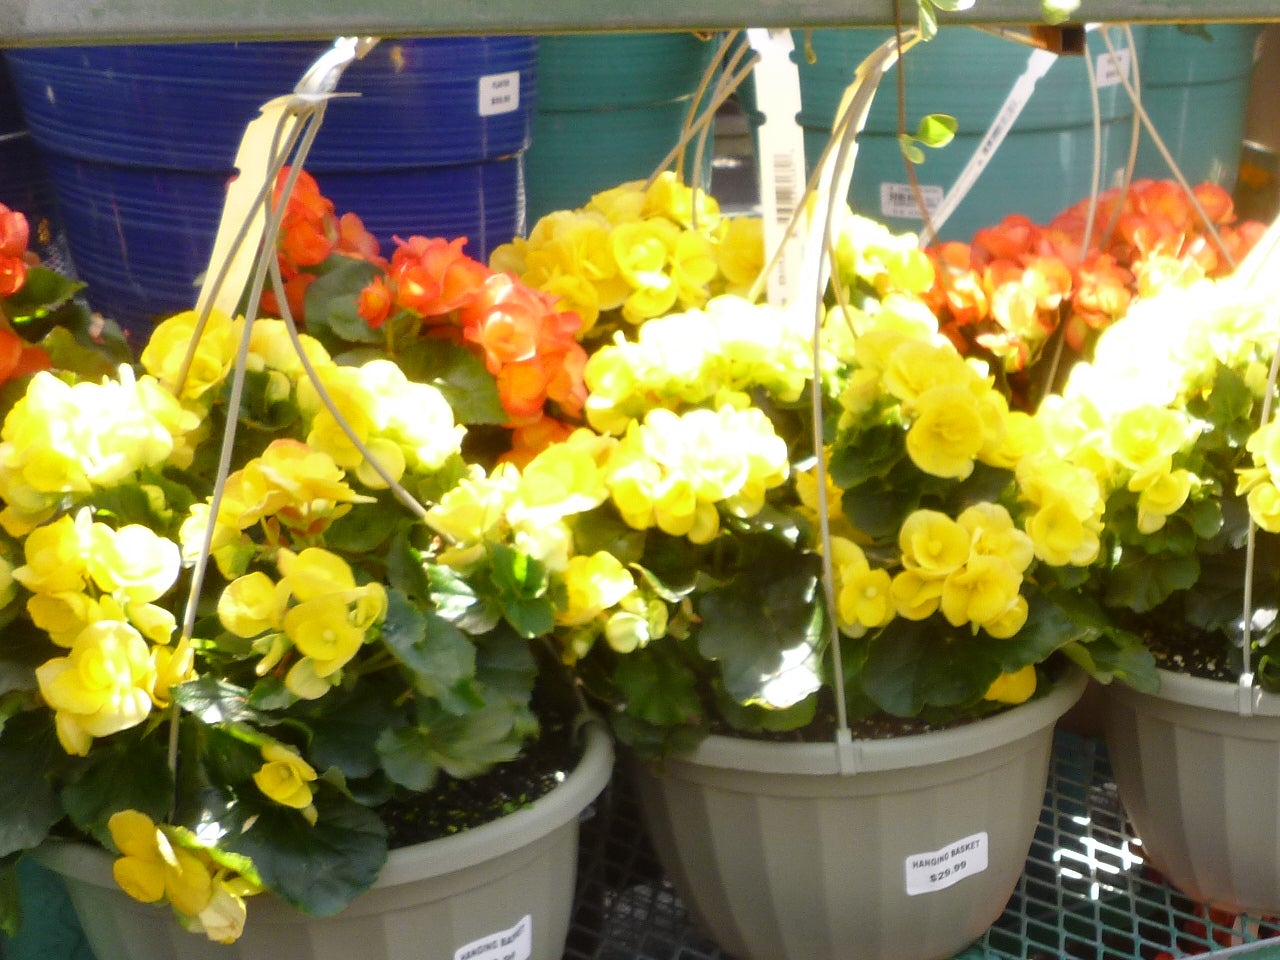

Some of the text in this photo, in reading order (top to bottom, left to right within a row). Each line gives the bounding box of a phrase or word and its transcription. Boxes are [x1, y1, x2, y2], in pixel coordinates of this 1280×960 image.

[912, 839, 981, 869] HANGING BASKET
[929, 861, 967, 882] $29.99
